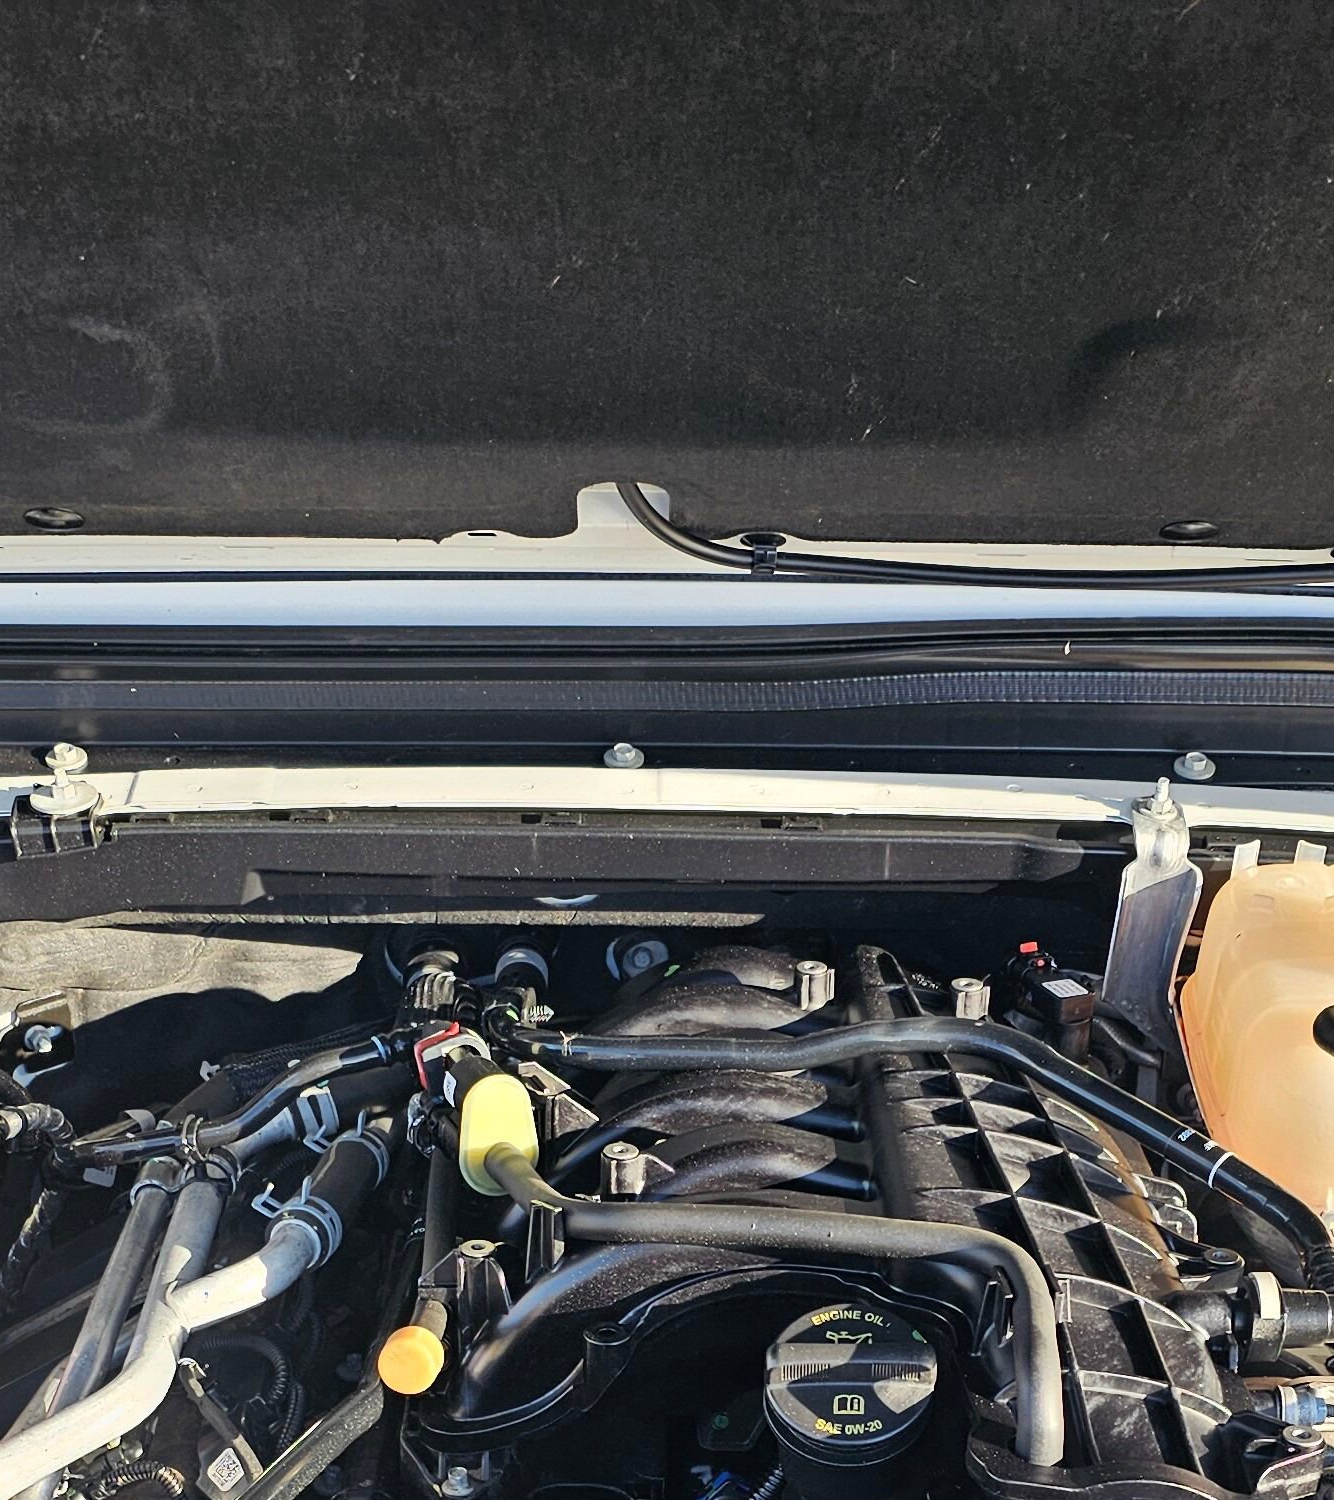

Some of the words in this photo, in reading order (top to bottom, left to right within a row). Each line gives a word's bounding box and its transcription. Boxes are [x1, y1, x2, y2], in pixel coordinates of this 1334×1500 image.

[810, 1309, 862, 1326] ENGINE
[864, 1312, 884, 1327] OIL
[815, 1418, 842, 1435] SAE
[844, 1419, 883, 1435] 0W-20
